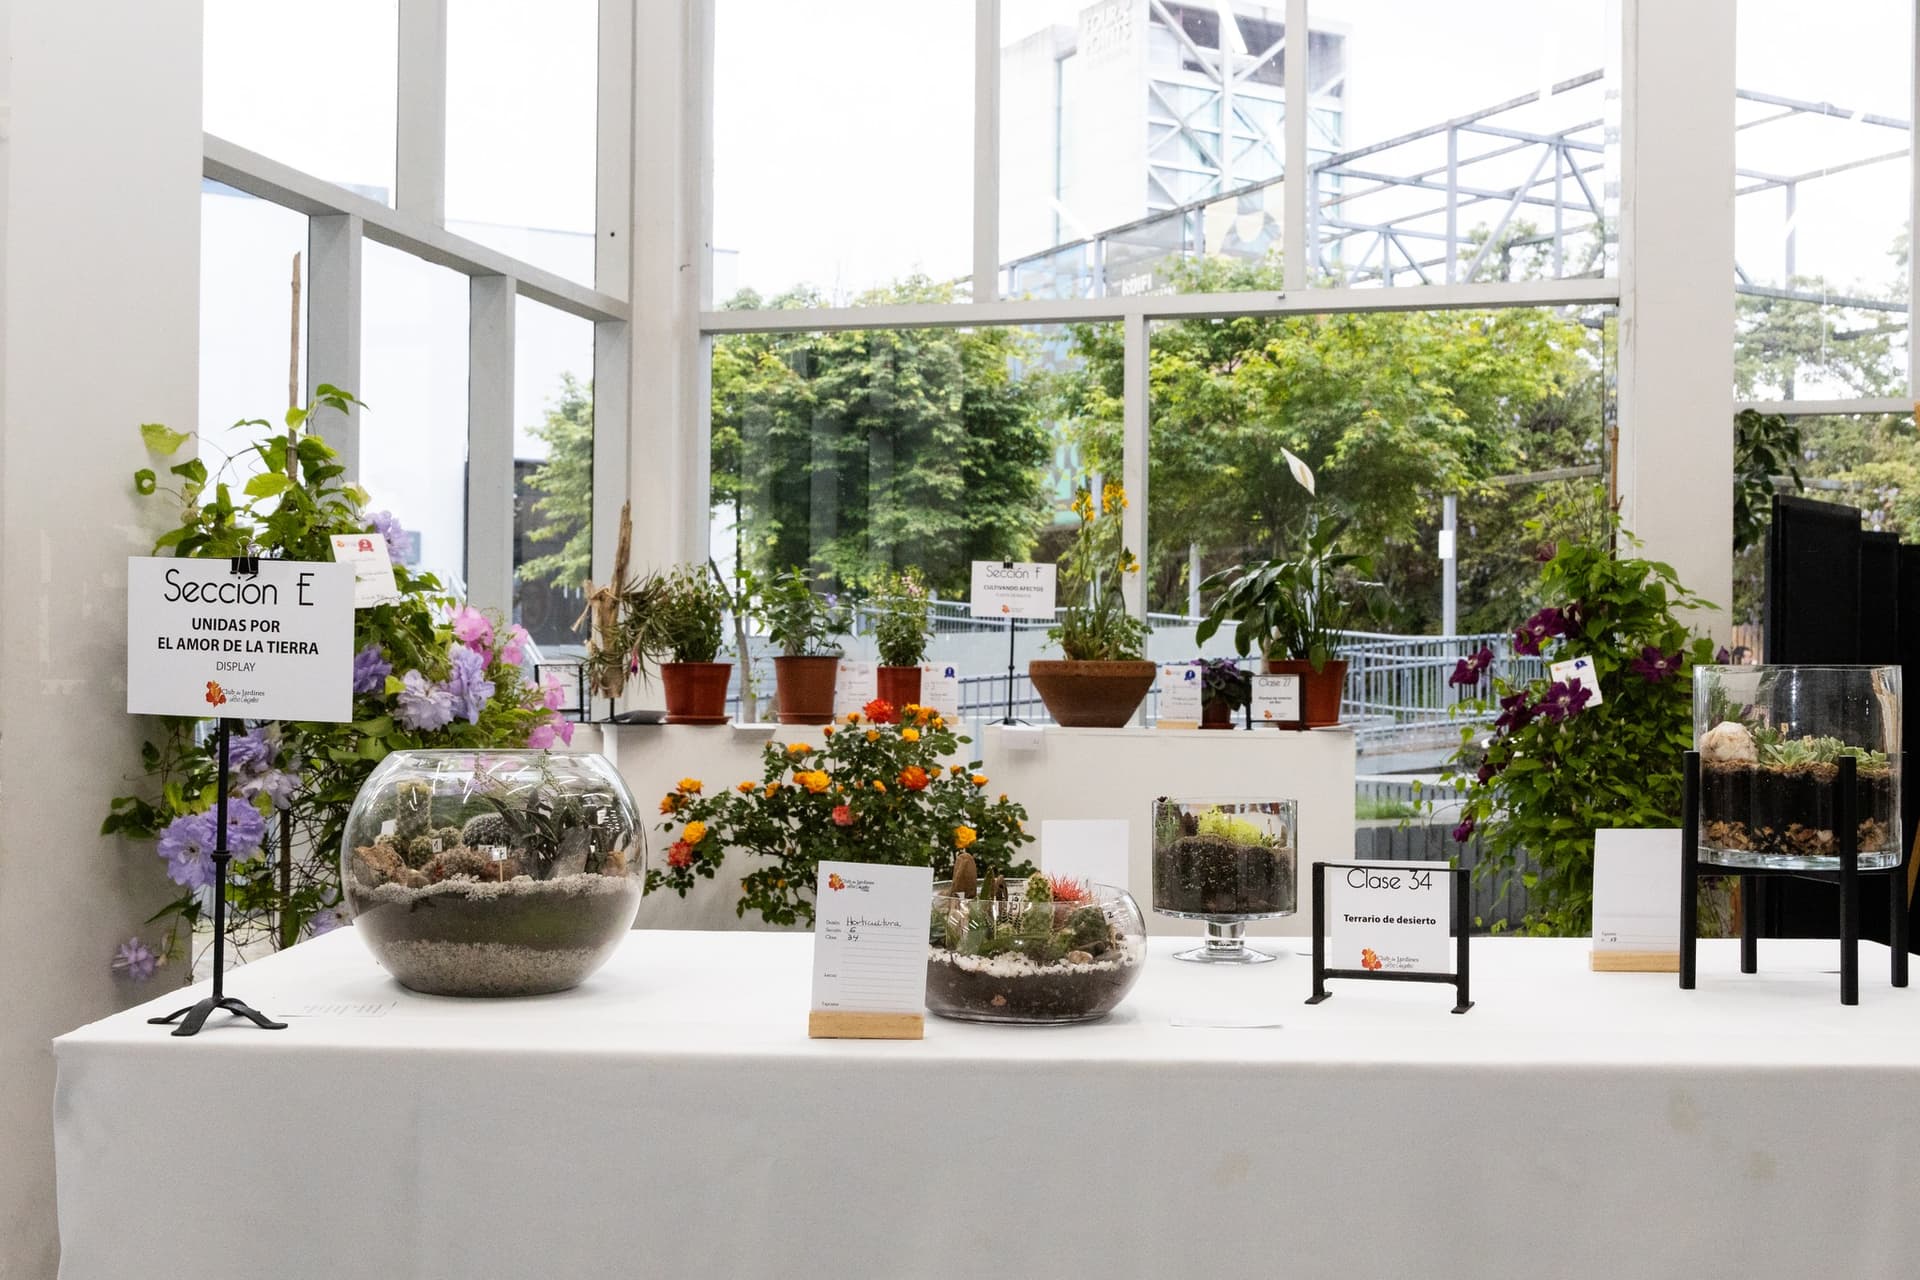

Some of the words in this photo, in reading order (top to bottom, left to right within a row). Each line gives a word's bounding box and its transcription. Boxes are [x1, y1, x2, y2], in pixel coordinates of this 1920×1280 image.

[986, 565, 1029, 579] Sección
[164, 568, 278, 605] Sección
[296, 572, 315, 606] E
[192, 617, 247, 632] UNIDAS
[250, 619, 280, 633] POR
[158, 636, 173, 650] EL
[176, 638, 220, 652] AMOR
[223, 639, 242, 652] DE
[246, 640, 264, 653] LA
[266, 640, 319, 655] TIERRA
[216, 661, 256, 672] DISPLAY
[1347, 867, 1401, 890] Clase
[1408, 868, 1433, 891] 34
[1344, 914, 1381, 924] Terrario
[1382, 915, 1395, 924] de
[1396, 915, 1437, 925] desierto
